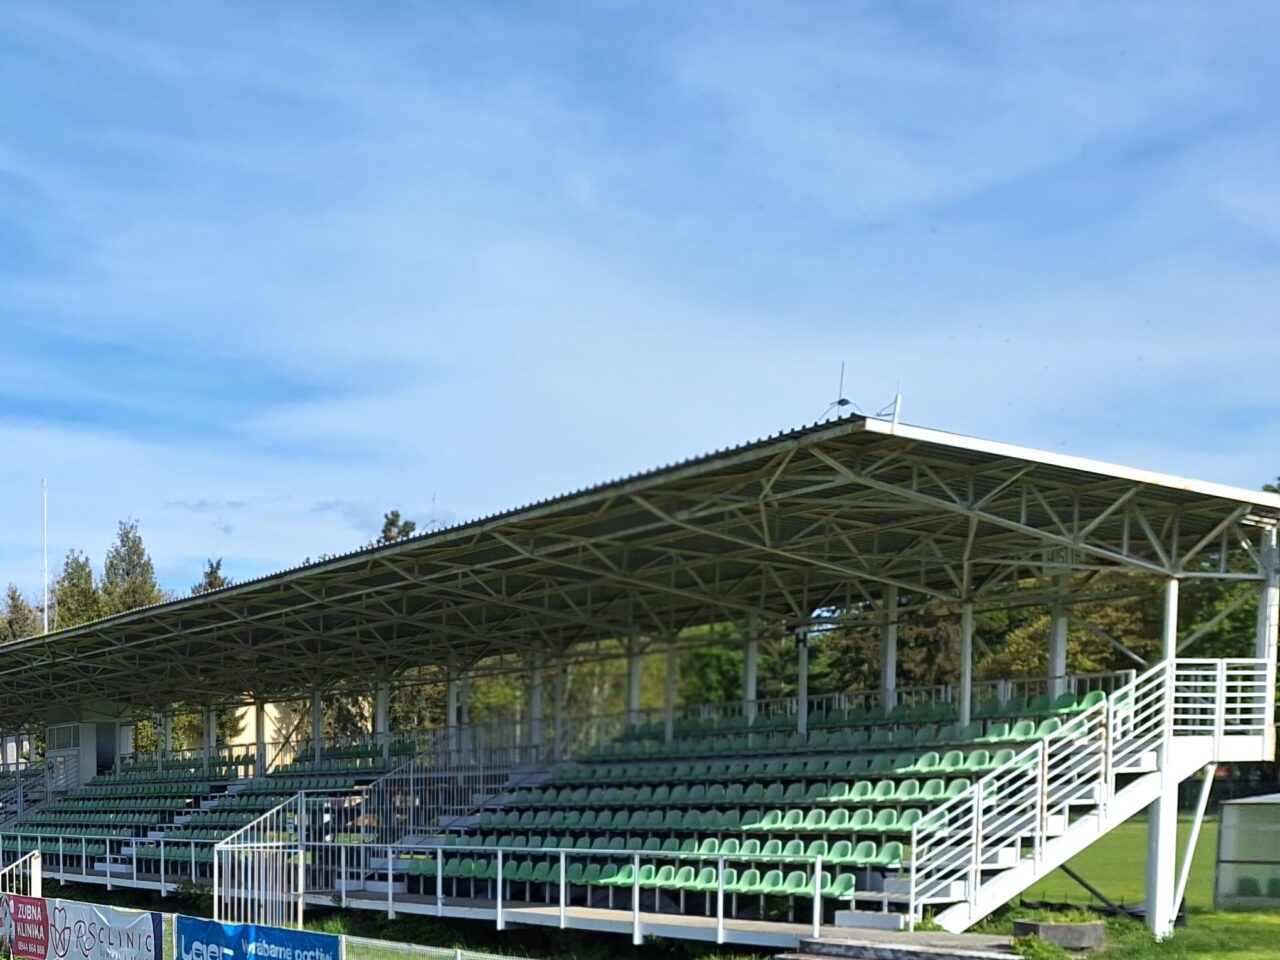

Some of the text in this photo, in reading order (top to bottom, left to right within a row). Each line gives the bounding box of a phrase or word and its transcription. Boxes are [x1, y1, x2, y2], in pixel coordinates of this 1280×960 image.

[17, 902, 42, 922] ZUBNÁ
[16, 921, 45, 940] KLINIKA
[241, 938, 292, 960] Vyrábame
